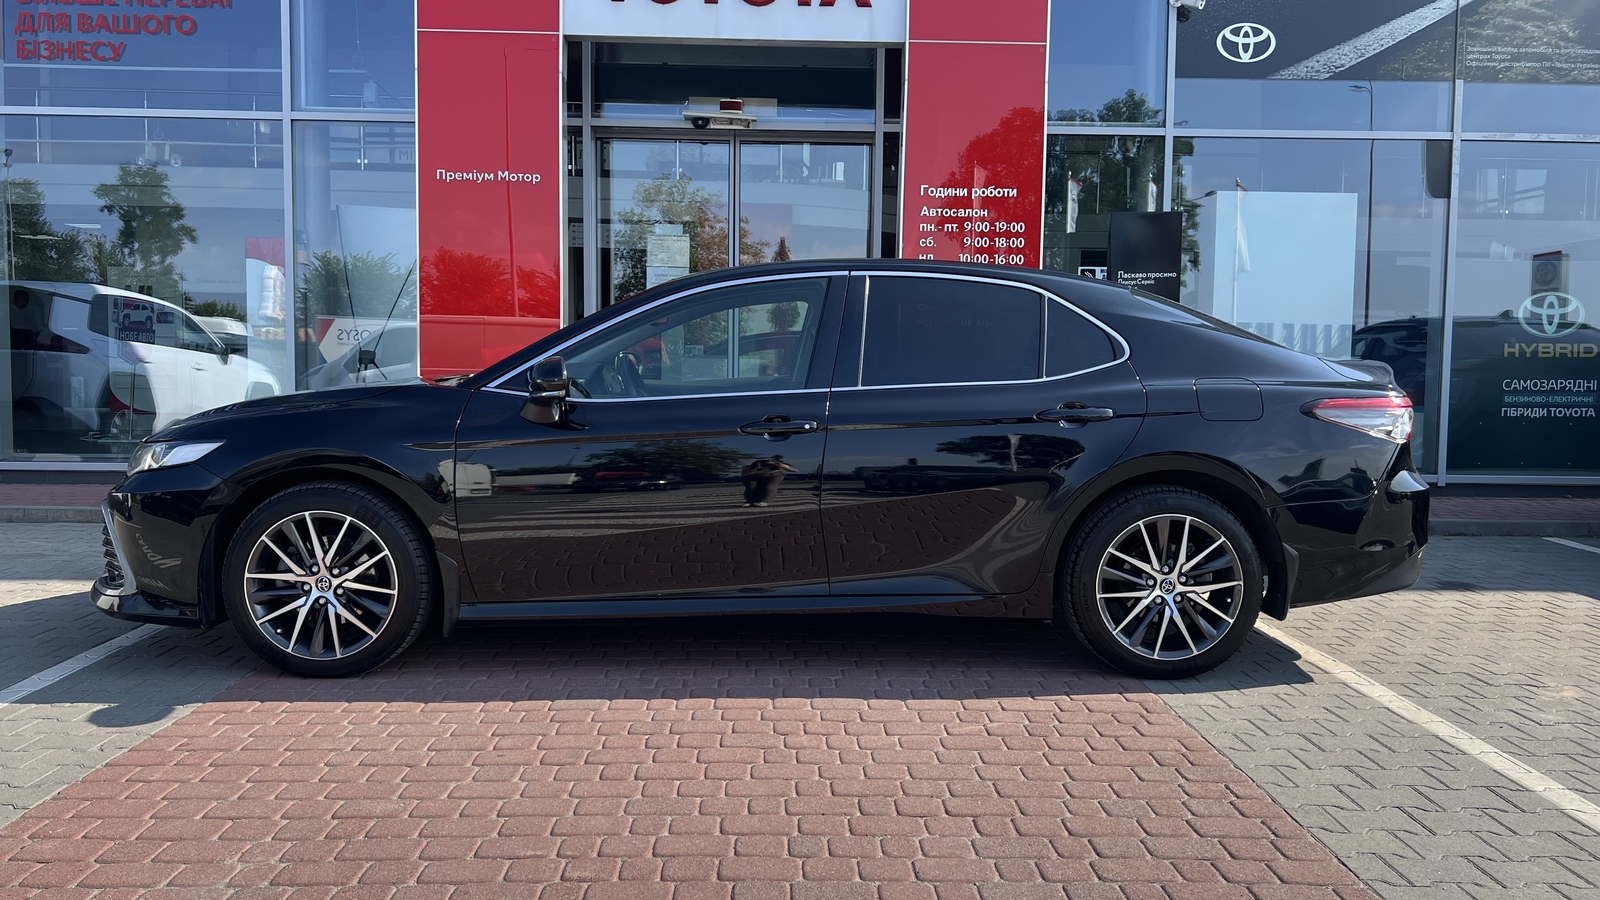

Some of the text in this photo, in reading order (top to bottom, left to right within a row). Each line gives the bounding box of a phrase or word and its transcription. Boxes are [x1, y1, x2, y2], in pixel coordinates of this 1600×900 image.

[15, 12, 197, 35] ДЛЯ ВАШОГО
[16, 39, 125, 61] БІЗНЕСУ
[436, 169, 541, 184] Преміум Мотор
[920, 185, 1017, 200] Години роботи
[920, 206, 988, 217] Автосалон
[919, 237, 937, 247] сб.
[1118, 271, 1147, 279] Ласкаво
[119, 331, 154, 343] НОВЕ АВТО
[1503, 343, 1598, 358] HYBRID
[1502, 379, 1597, 392] САМОЗАРЯДНІ
[1504, 395, 1593, 403] БЕНЗИНОВО-ЕЛЕКТРИЧНІ
[1501, 407, 1595, 418] ГІБРИДИ TOYOTA
